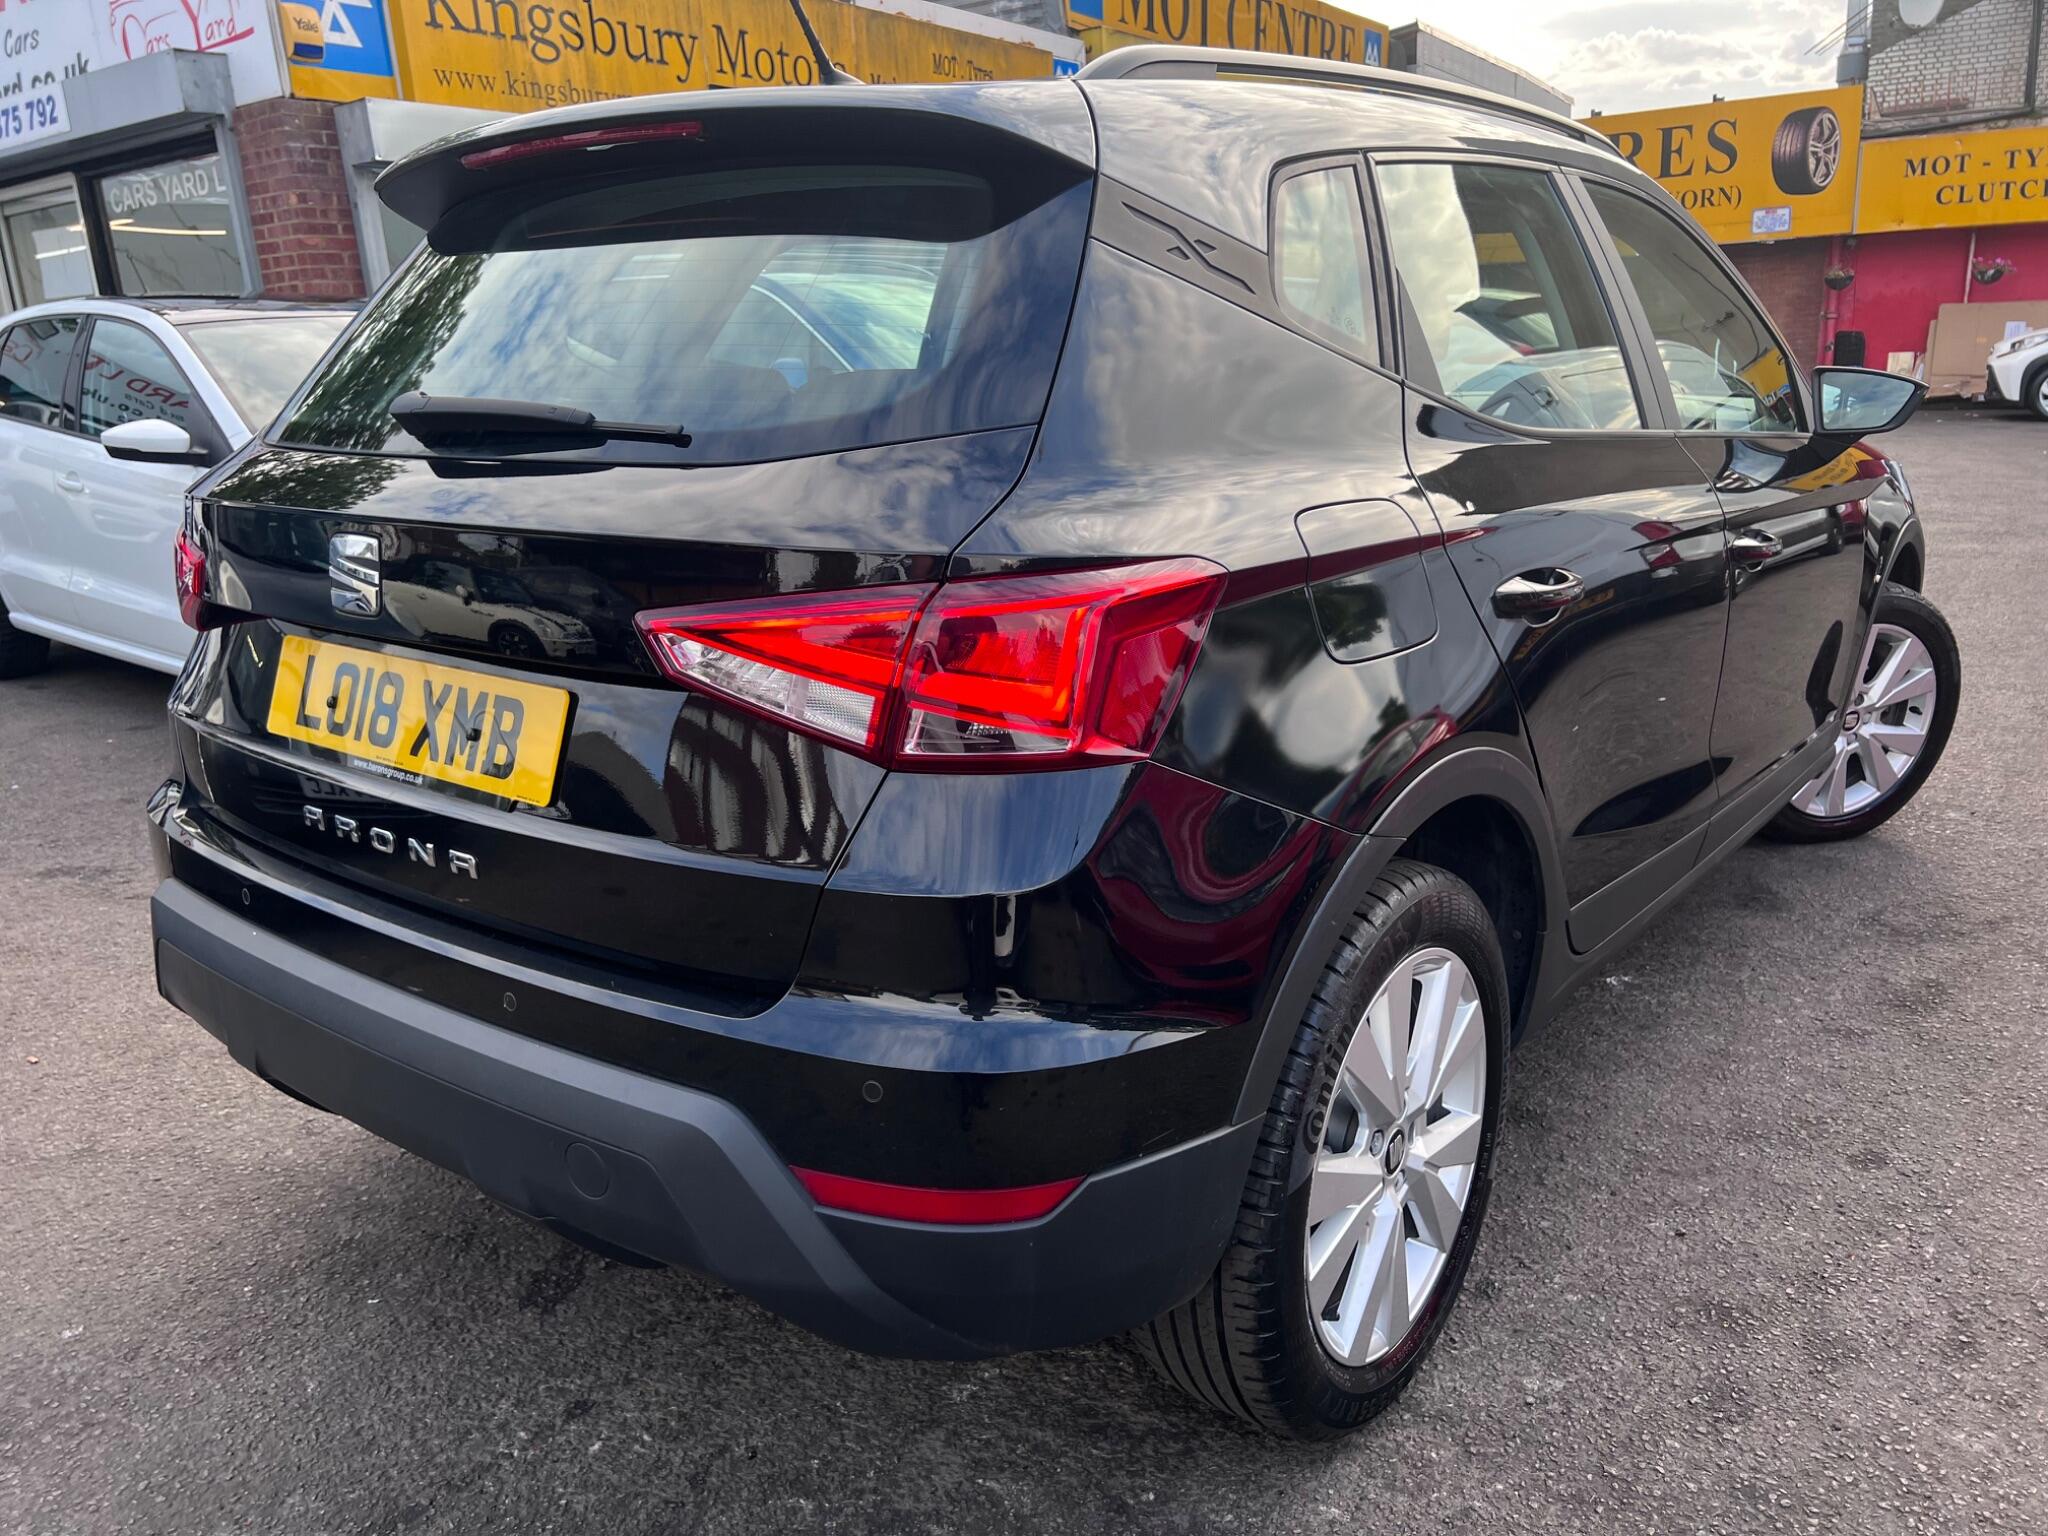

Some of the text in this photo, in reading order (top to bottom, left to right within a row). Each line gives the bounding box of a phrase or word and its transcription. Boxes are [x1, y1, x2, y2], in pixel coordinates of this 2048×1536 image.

[4, 28, 40, 58] Cars
[293, 15, 320, 34] Yale
[426, 0, 846, 87] Kingsbury Moto
[0, 94, 59, 139] 75 792
[1904, 153, 1972, 178] MOT
[2004, 146, 2048, 170] TY
[110, 180, 158, 214] CARS
[159, 168, 209, 203] YARD
[1669, 184, 1742, 210] ORN)
[296, 654, 525, 780] LO18 XMB
[303, 804, 480, 880] ARONA
